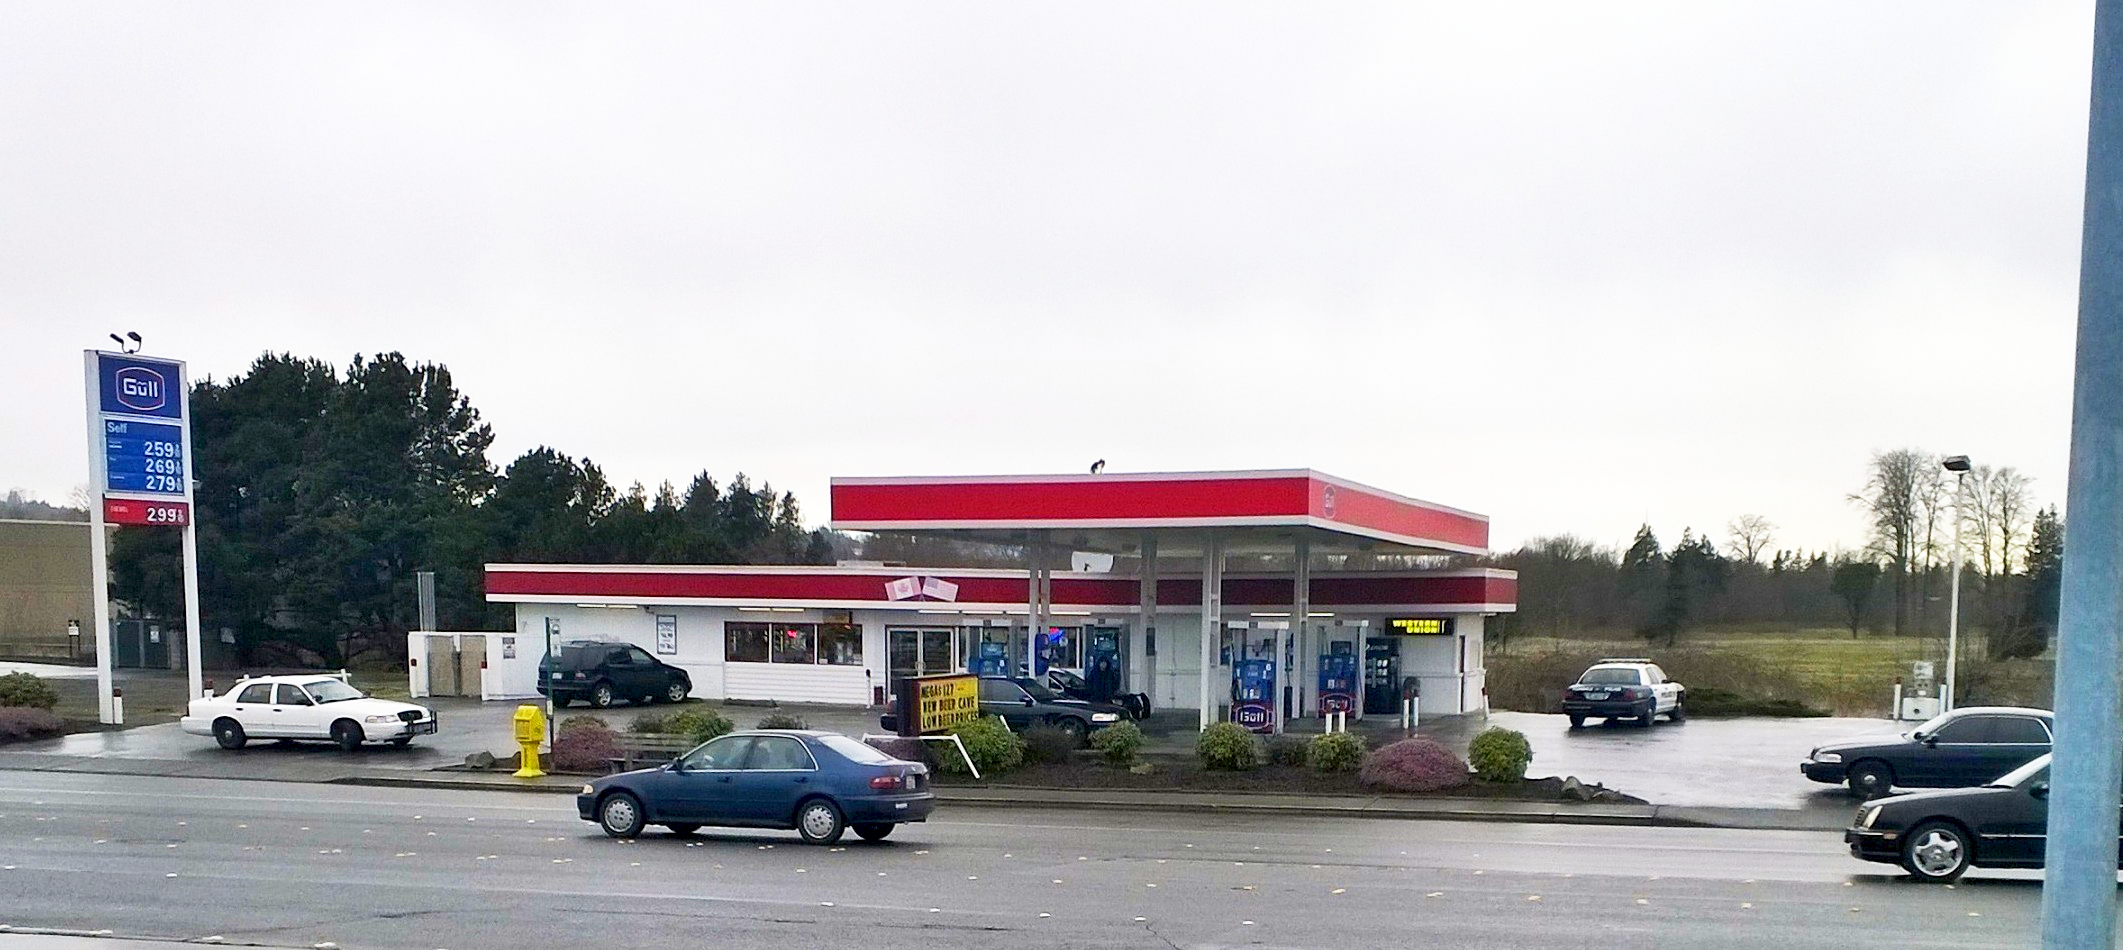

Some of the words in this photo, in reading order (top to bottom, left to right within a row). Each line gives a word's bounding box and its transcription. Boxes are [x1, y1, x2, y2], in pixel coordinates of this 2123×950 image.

[107, 422, 128, 433] Self
[144, 441, 174, 458] 259
[145, 458, 175, 475] 269
[146, 475, 176, 492] 279
[147, 507, 177, 523] 299
[1392, 620, 1438, 628] WESTERN
[1406, 626, 1438, 634] UNION
[923, 700, 937, 713] NEW
[939, 698, 956, 712] BEER
[958, 696, 975, 709] CAVE
[922, 715, 937, 729] LOW
